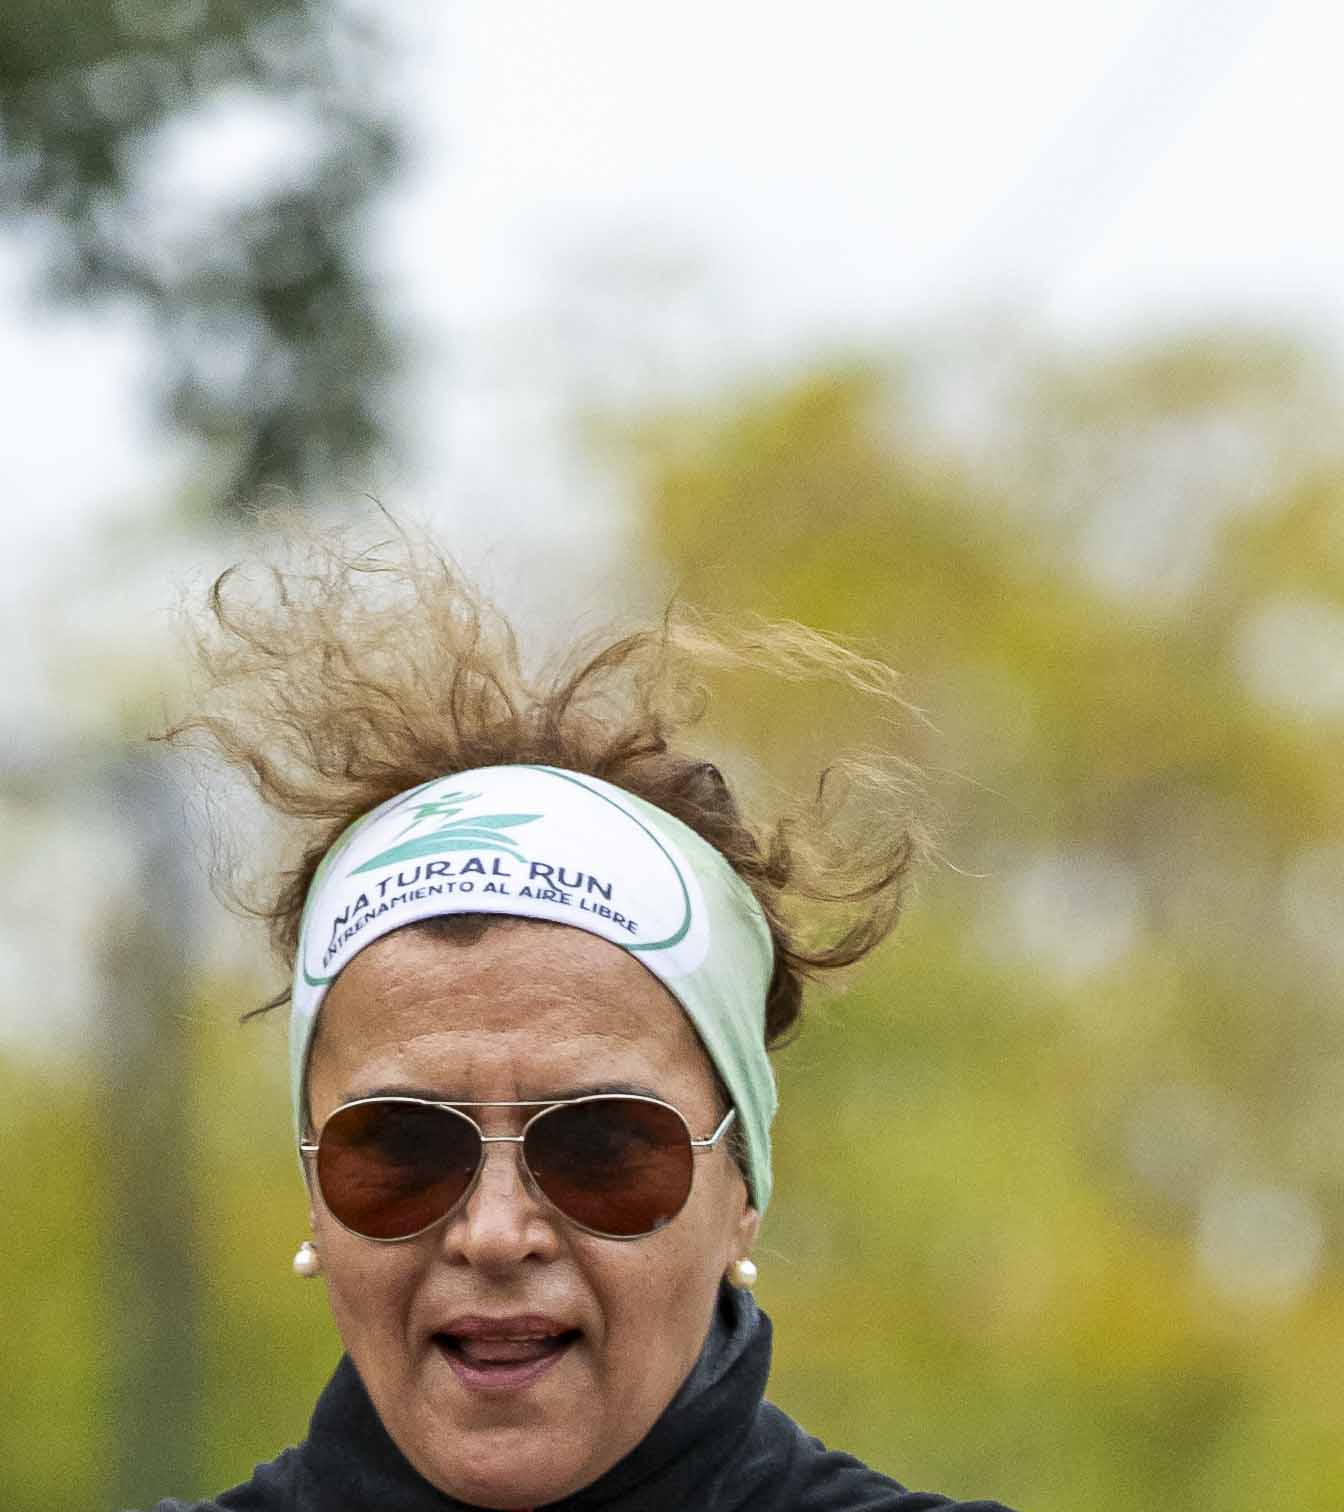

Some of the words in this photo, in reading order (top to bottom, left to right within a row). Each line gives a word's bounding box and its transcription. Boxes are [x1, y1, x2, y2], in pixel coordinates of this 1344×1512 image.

[323, 881, 474, 968] ENTRENAMIENTO
[483, 881, 511, 895] AL
[518, 885, 573, 906] AIRE
[579, 897, 639, 935] LIBRE
[331, 856, 512, 944] NATURAL
[529, 862, 612, 901] RUN
